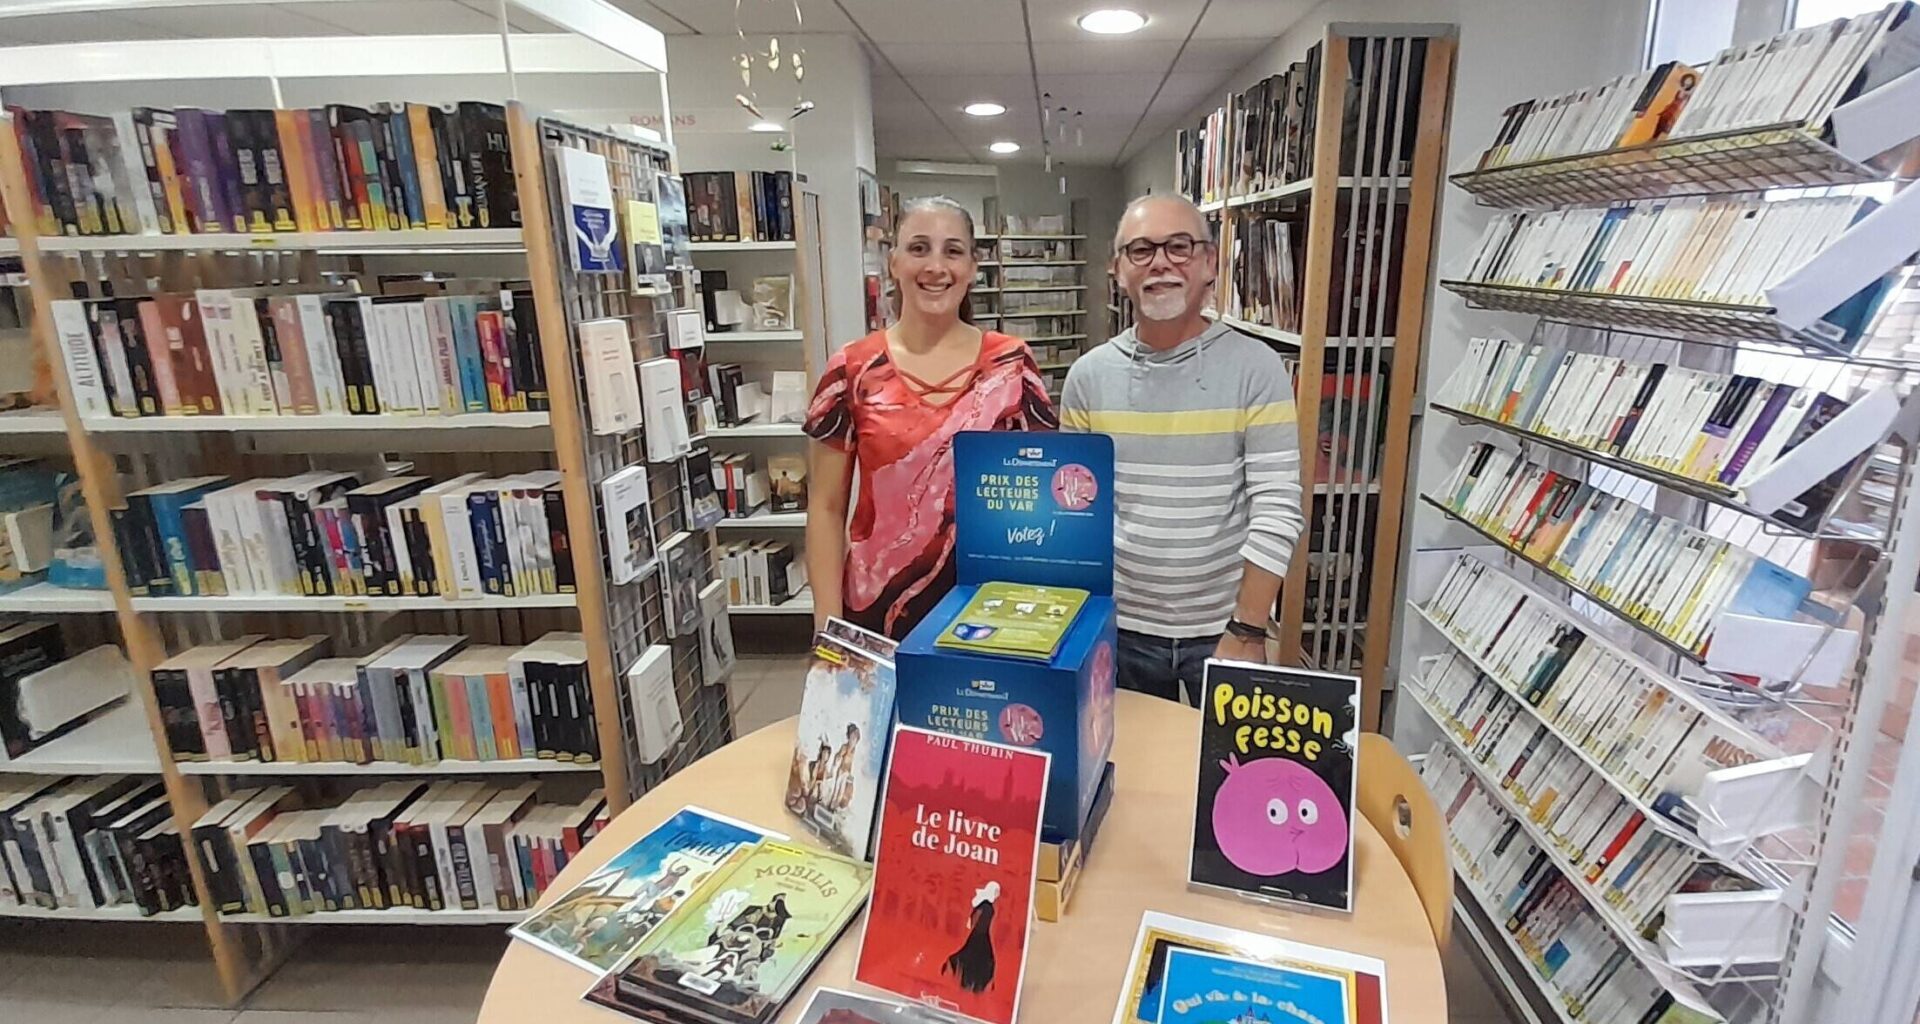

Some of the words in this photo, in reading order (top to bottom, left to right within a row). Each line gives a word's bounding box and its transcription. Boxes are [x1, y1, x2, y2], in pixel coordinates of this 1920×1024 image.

[630, 114, 696, 127] ROMNS
[67, 333, 95, 387] ALTITUDE
[981, 474, 1010, 486] PRIX
[1016, 475, 1039, 487] DES
[976, 486, 1039, 500] LECTEURS
[987, 499, 1004, 510] DU
[1009, 499, 1034, 512] VAR
[1007, 526, 1045, 546] Votez
[931, 704, 960, 717] PRIX
[965, 708, 988, 720] DES
[1214, 683, 1333, 739] Poisson
[927, 715, 989, 732] LECTEURS
[927, 735, 958, 750] PAUL
[964, 742, 1015, 760] THURIN
[915, 803, 942, 829] Le
[947, 808, 1002, 843] livre
[911, 825, 940, 850] de
[943, 833, 1000, 866] Joan
[756, 863, 839, 898] MOBILIS
